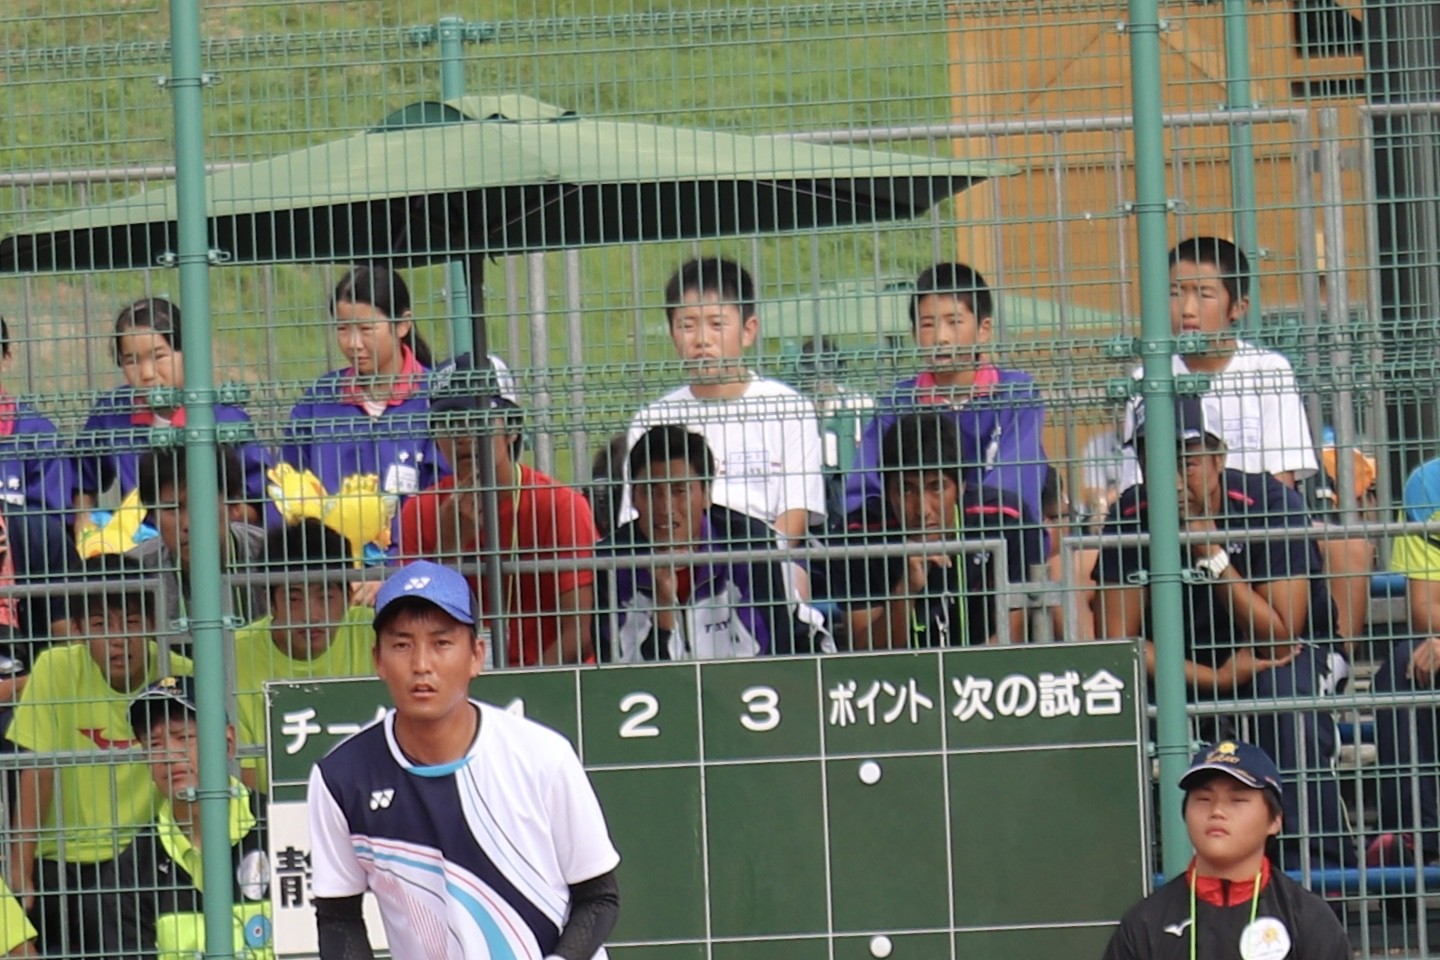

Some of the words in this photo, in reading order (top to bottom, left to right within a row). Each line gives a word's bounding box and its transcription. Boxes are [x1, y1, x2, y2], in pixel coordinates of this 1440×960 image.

[619, 692, 661, 738] 2
[740, 686, 782, 732] 3
[828, 679, 934, 728] ポイント
[951, 670, 1125, 723] 次の試合
[281, 706, 387, 754] チー
